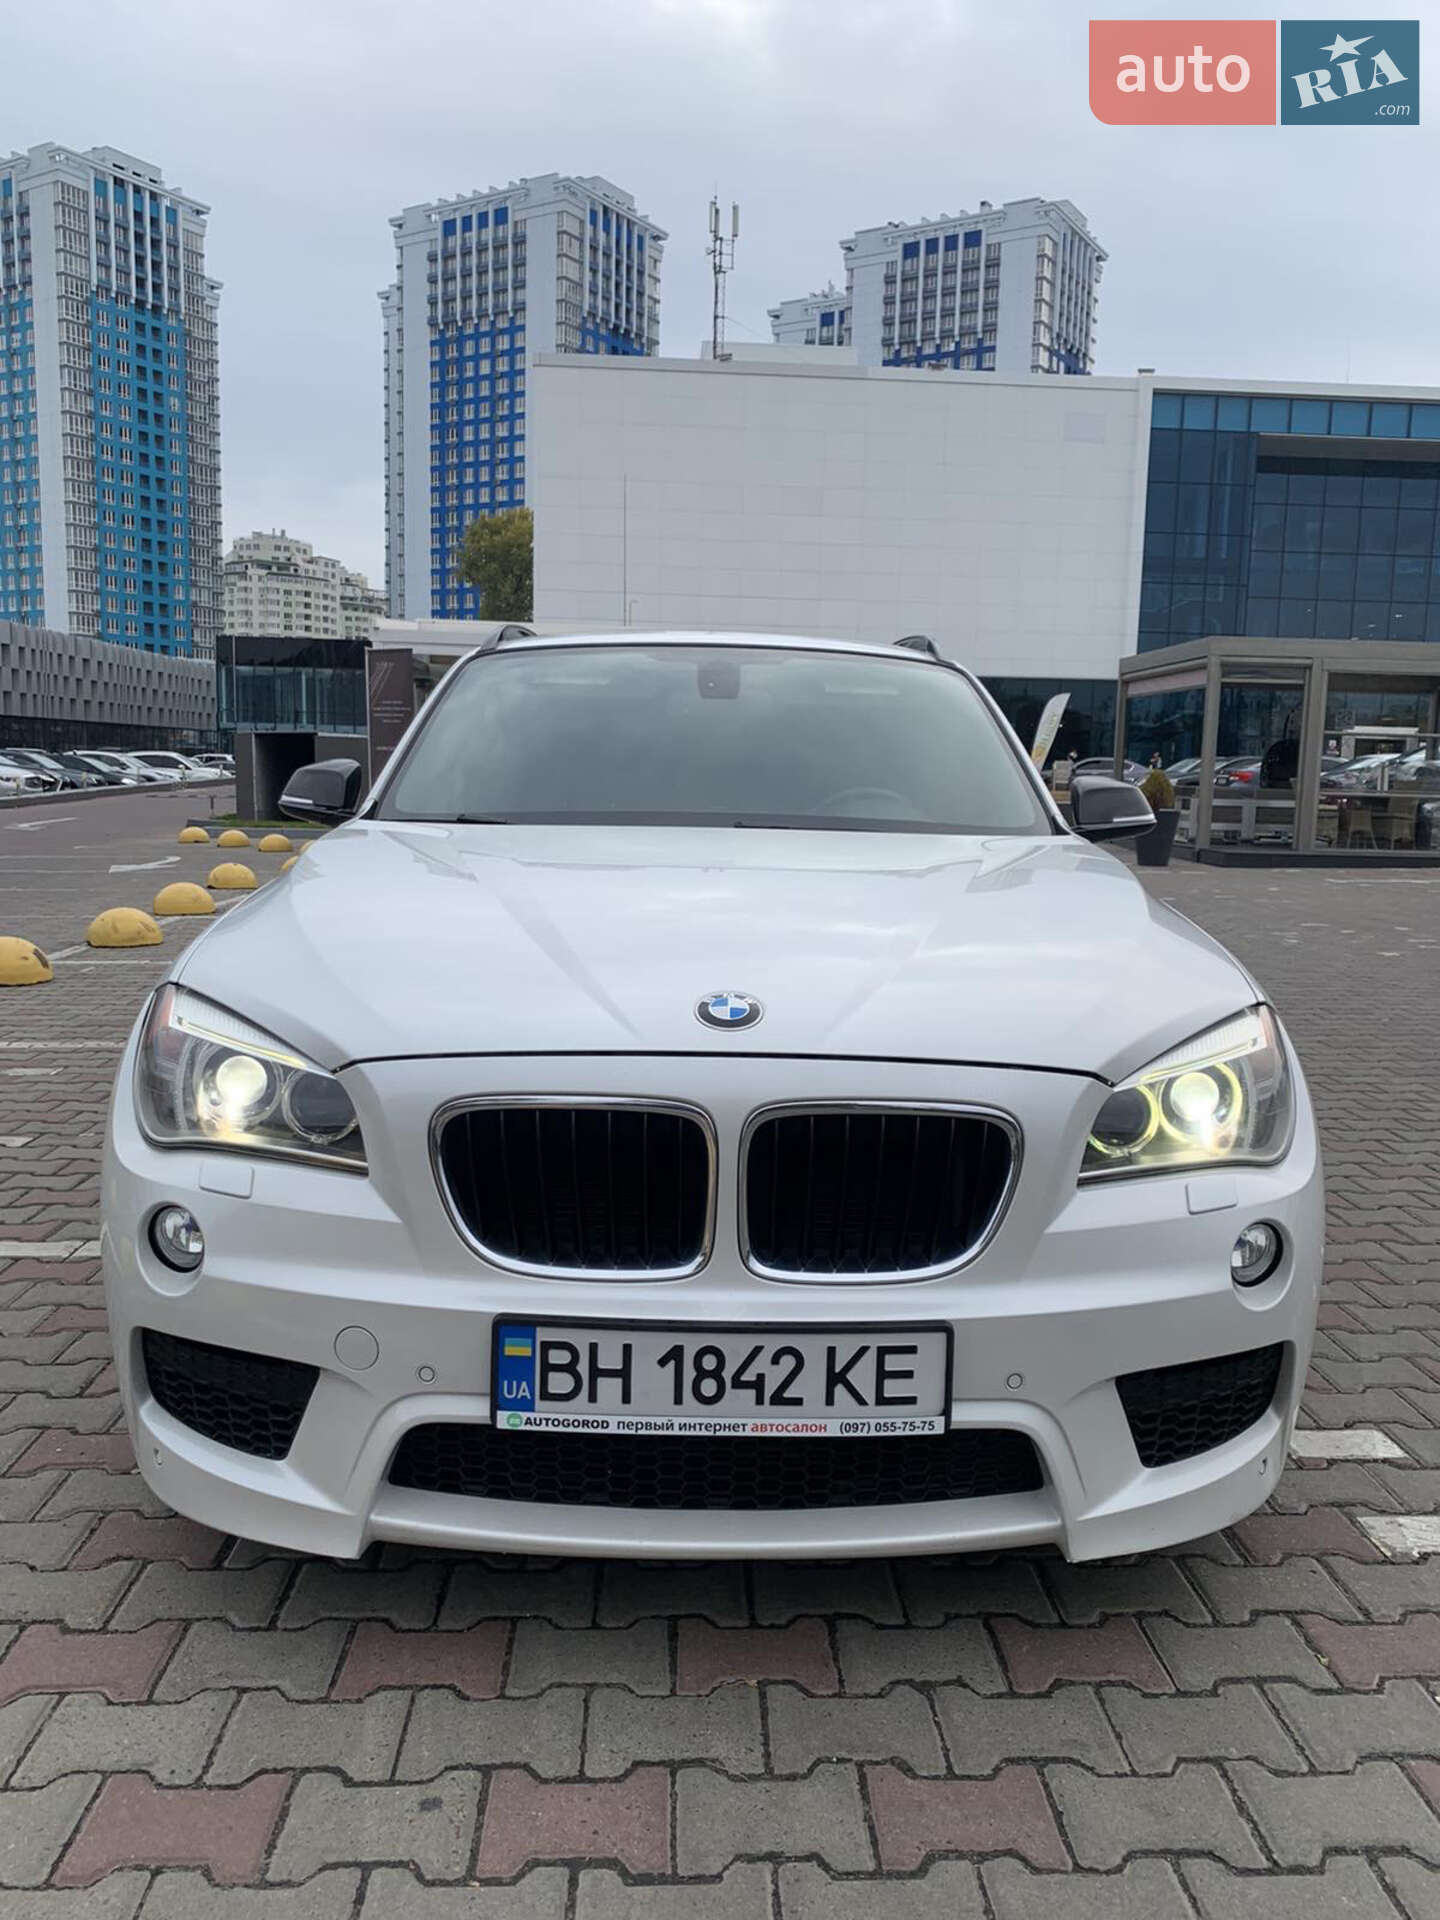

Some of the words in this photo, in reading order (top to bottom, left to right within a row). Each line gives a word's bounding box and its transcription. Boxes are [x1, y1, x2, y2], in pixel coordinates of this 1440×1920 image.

[539, 1340, 632, 1405] BH
[657, 1344, 805, 1407] 1842
[825, 1345, 918, 1407] KE
[503, 1381, 531, 1400] UA
[524, 1416, 610, 1430] AUTOGOROD
[617, 1418, 674, 1434] первый
[678, 1420, 747, 1435] интернет
[751, 1423, 827, 1433] автосалон
[839, 1421, 871, 1435] (097)
[875, 1420, 935, 1433] 055-75-75
